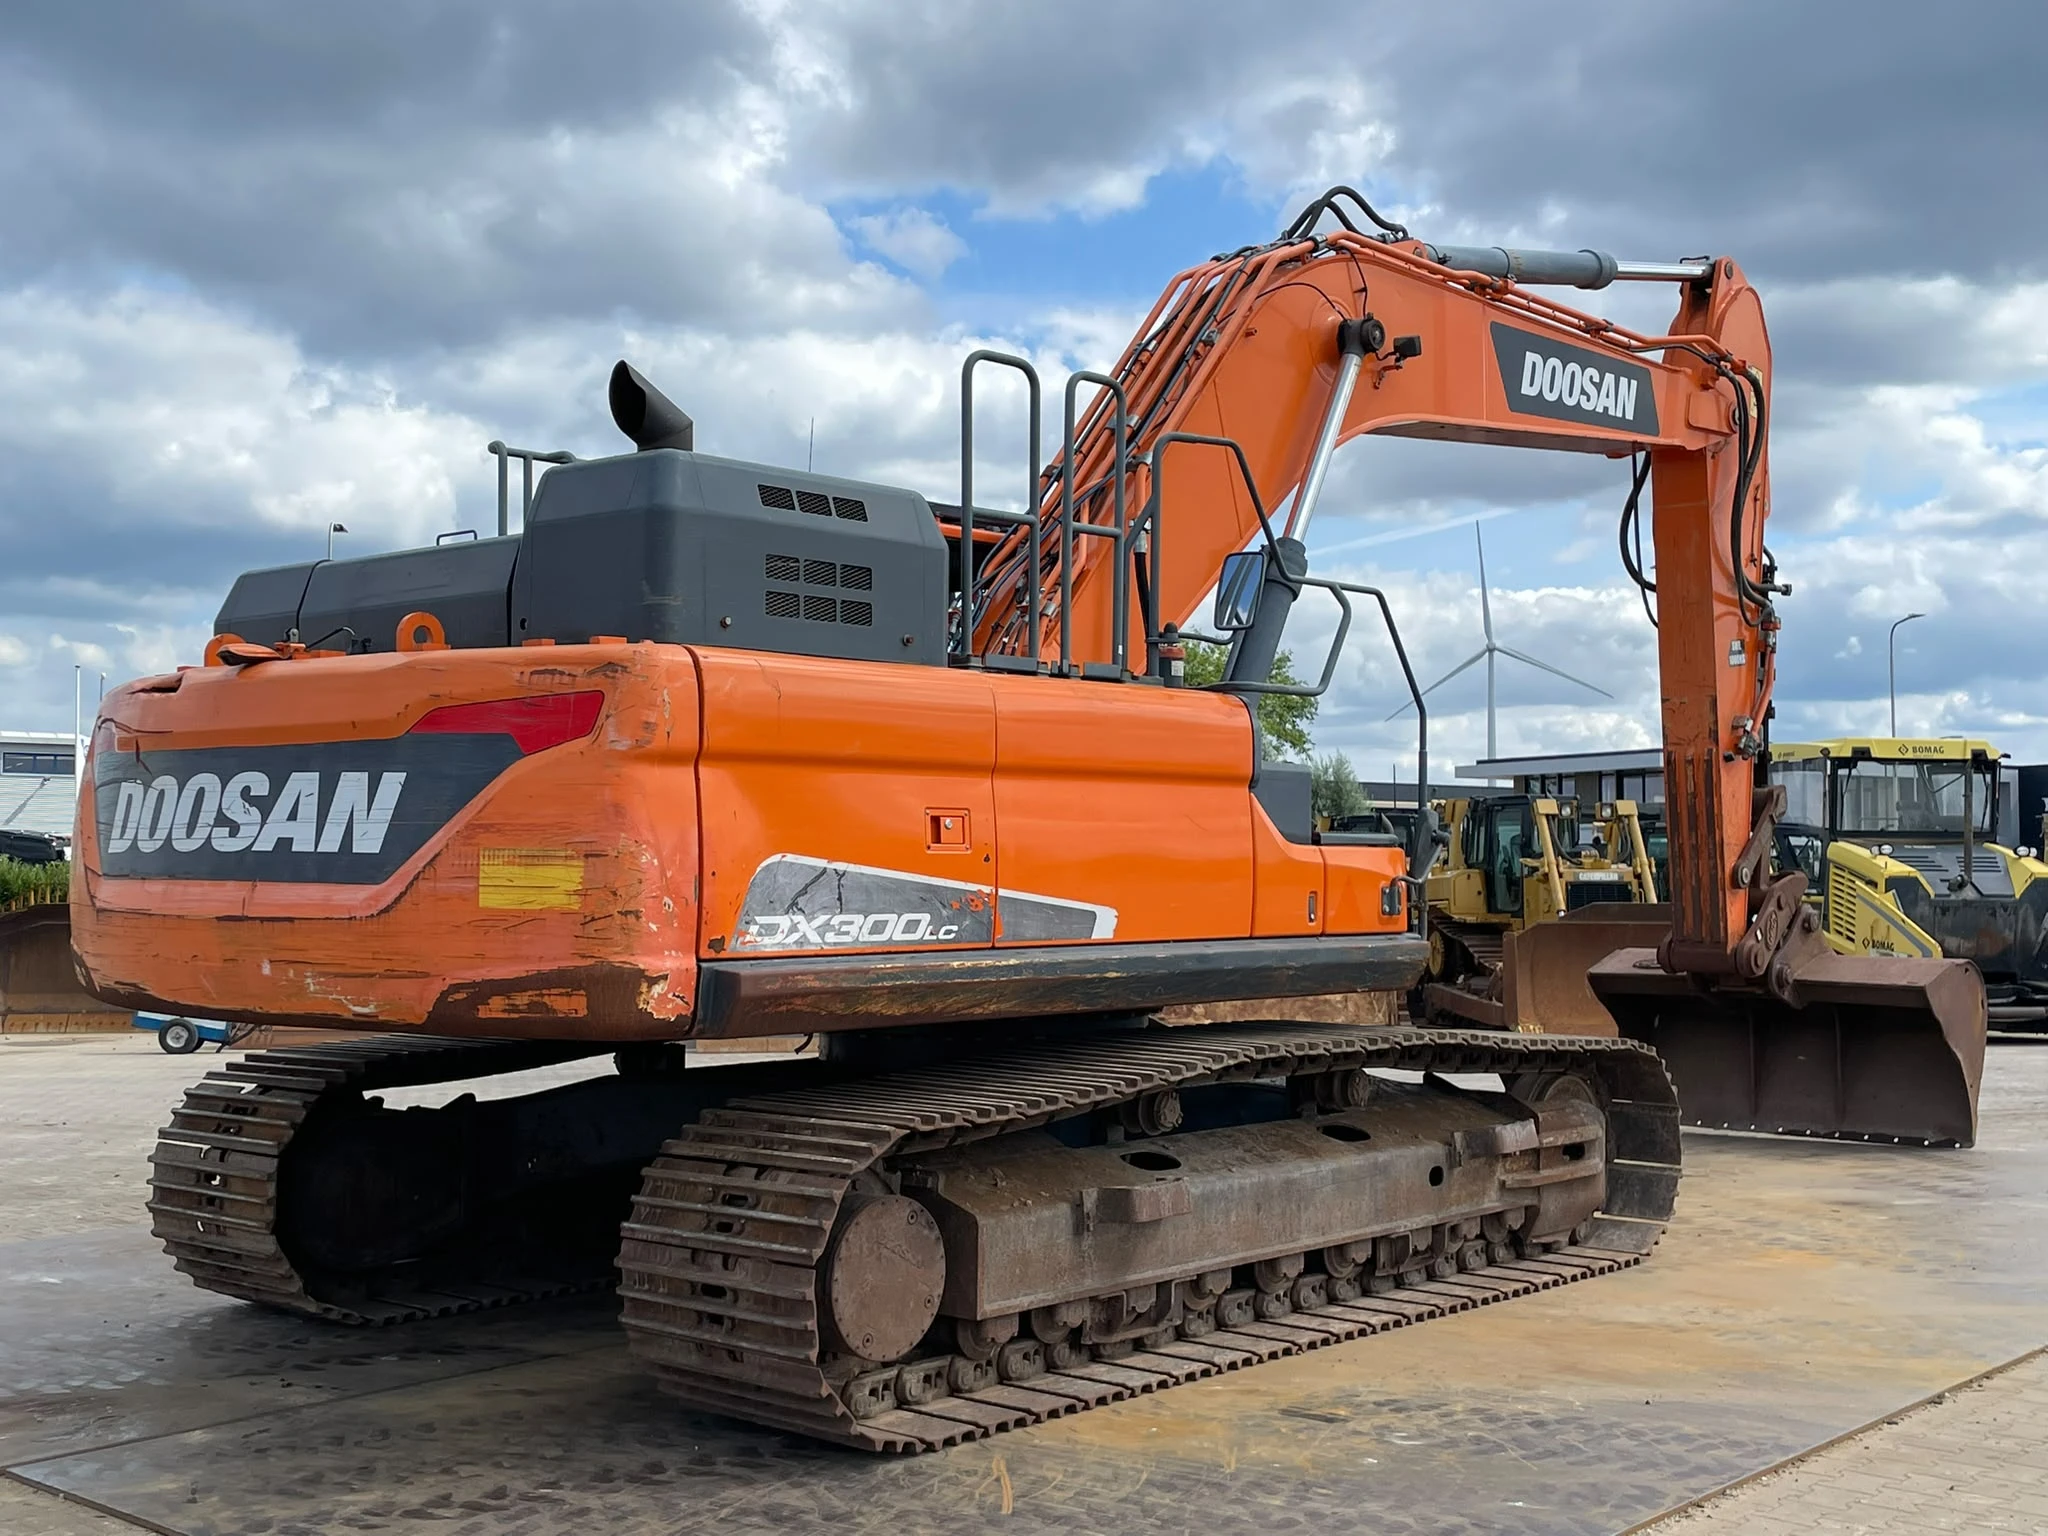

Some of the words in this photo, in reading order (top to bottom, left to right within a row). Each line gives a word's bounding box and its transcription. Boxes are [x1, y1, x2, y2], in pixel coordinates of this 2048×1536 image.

[1521, 351, 1638, 420] DOOSAN
[1912, 745, 1945, 754] BOMAG
[108, 771, 407, 853] DOOSAN
[1872, 940, 1895, 952] BOMAG
